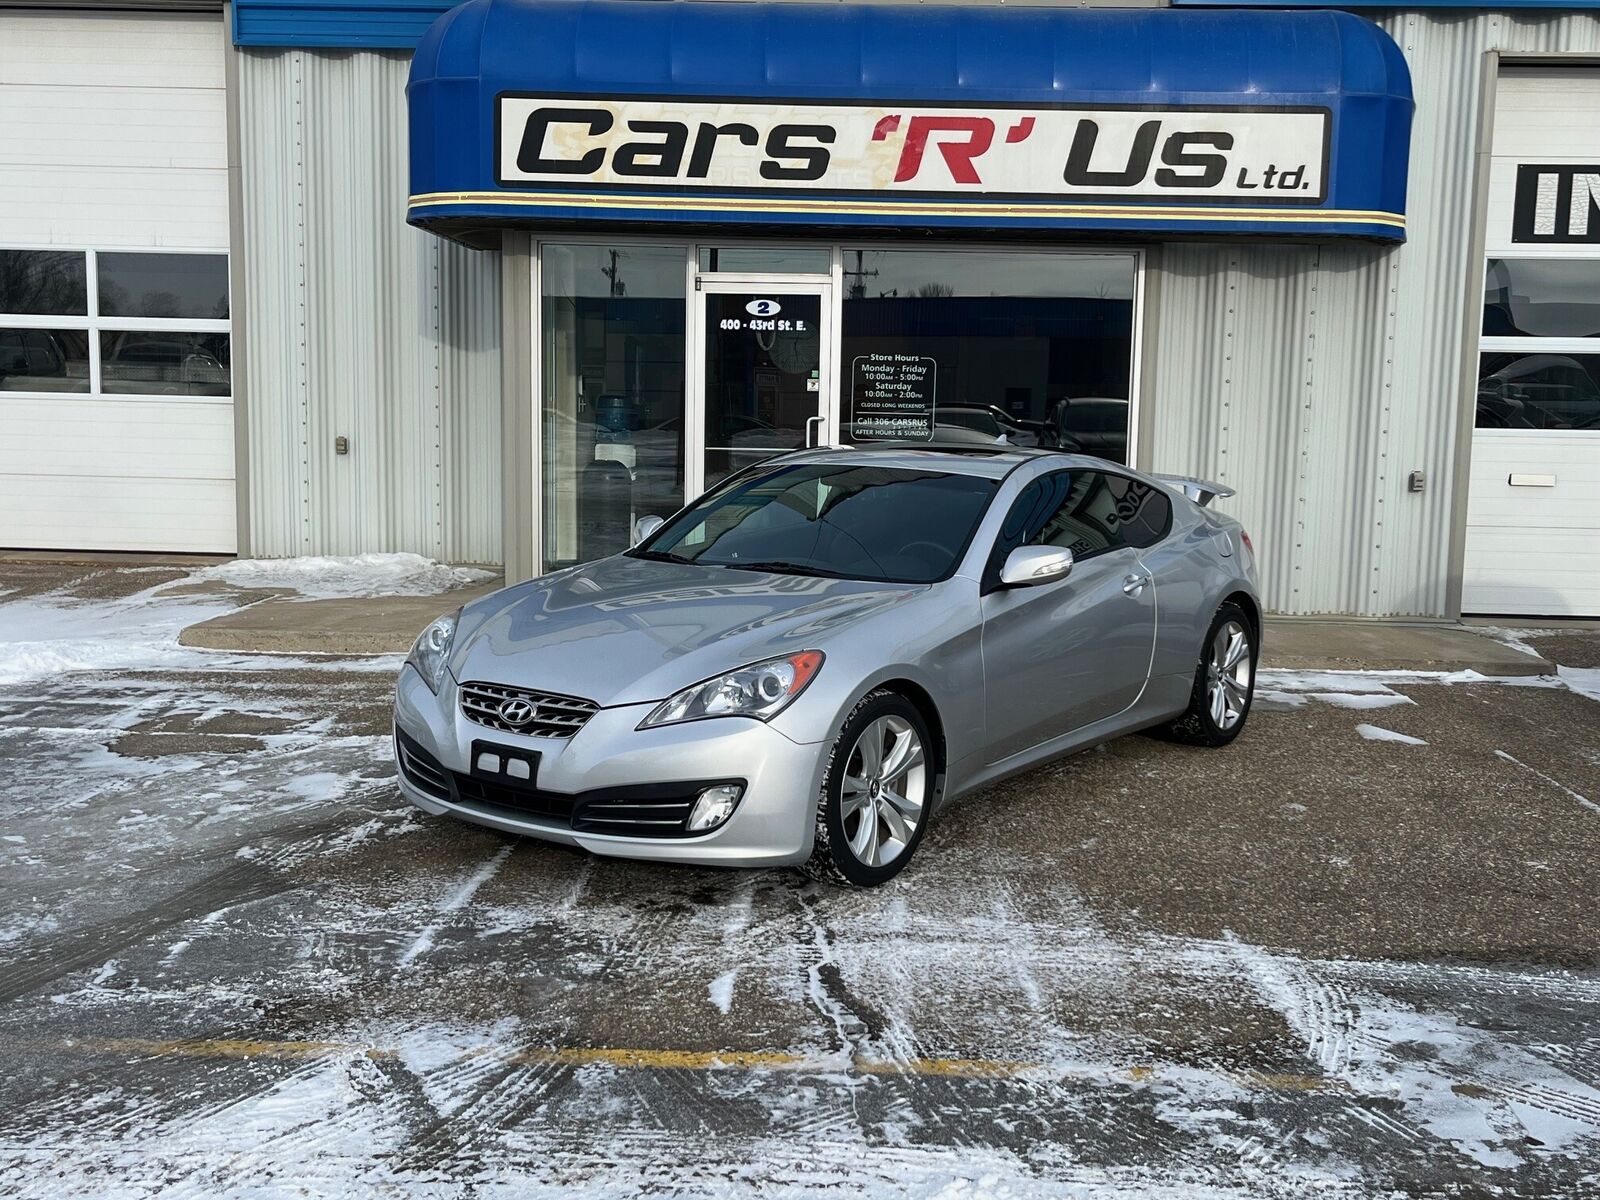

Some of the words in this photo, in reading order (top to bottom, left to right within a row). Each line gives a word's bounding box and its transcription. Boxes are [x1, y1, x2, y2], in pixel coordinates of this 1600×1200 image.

[516, 106, 838, 182] Cars
[1063, 118, 1234, 188] Us
[1237, 164, 1310, 190] Ltd.
[757, 301, 770, 314] 2
[720, 319, 741, 330] 400
[749, 319, 775, 331] 43rd
[777, 320, 793, 331] St.
[796, 320, 807, 331] E.
[870, 353, 893, 361] Store
[861, 364, 895, 374] Monday
[902, 365, 927, 375] Friday
[875, 382, 912, 391] Saturday
[857, 417, 872, 425] Call
